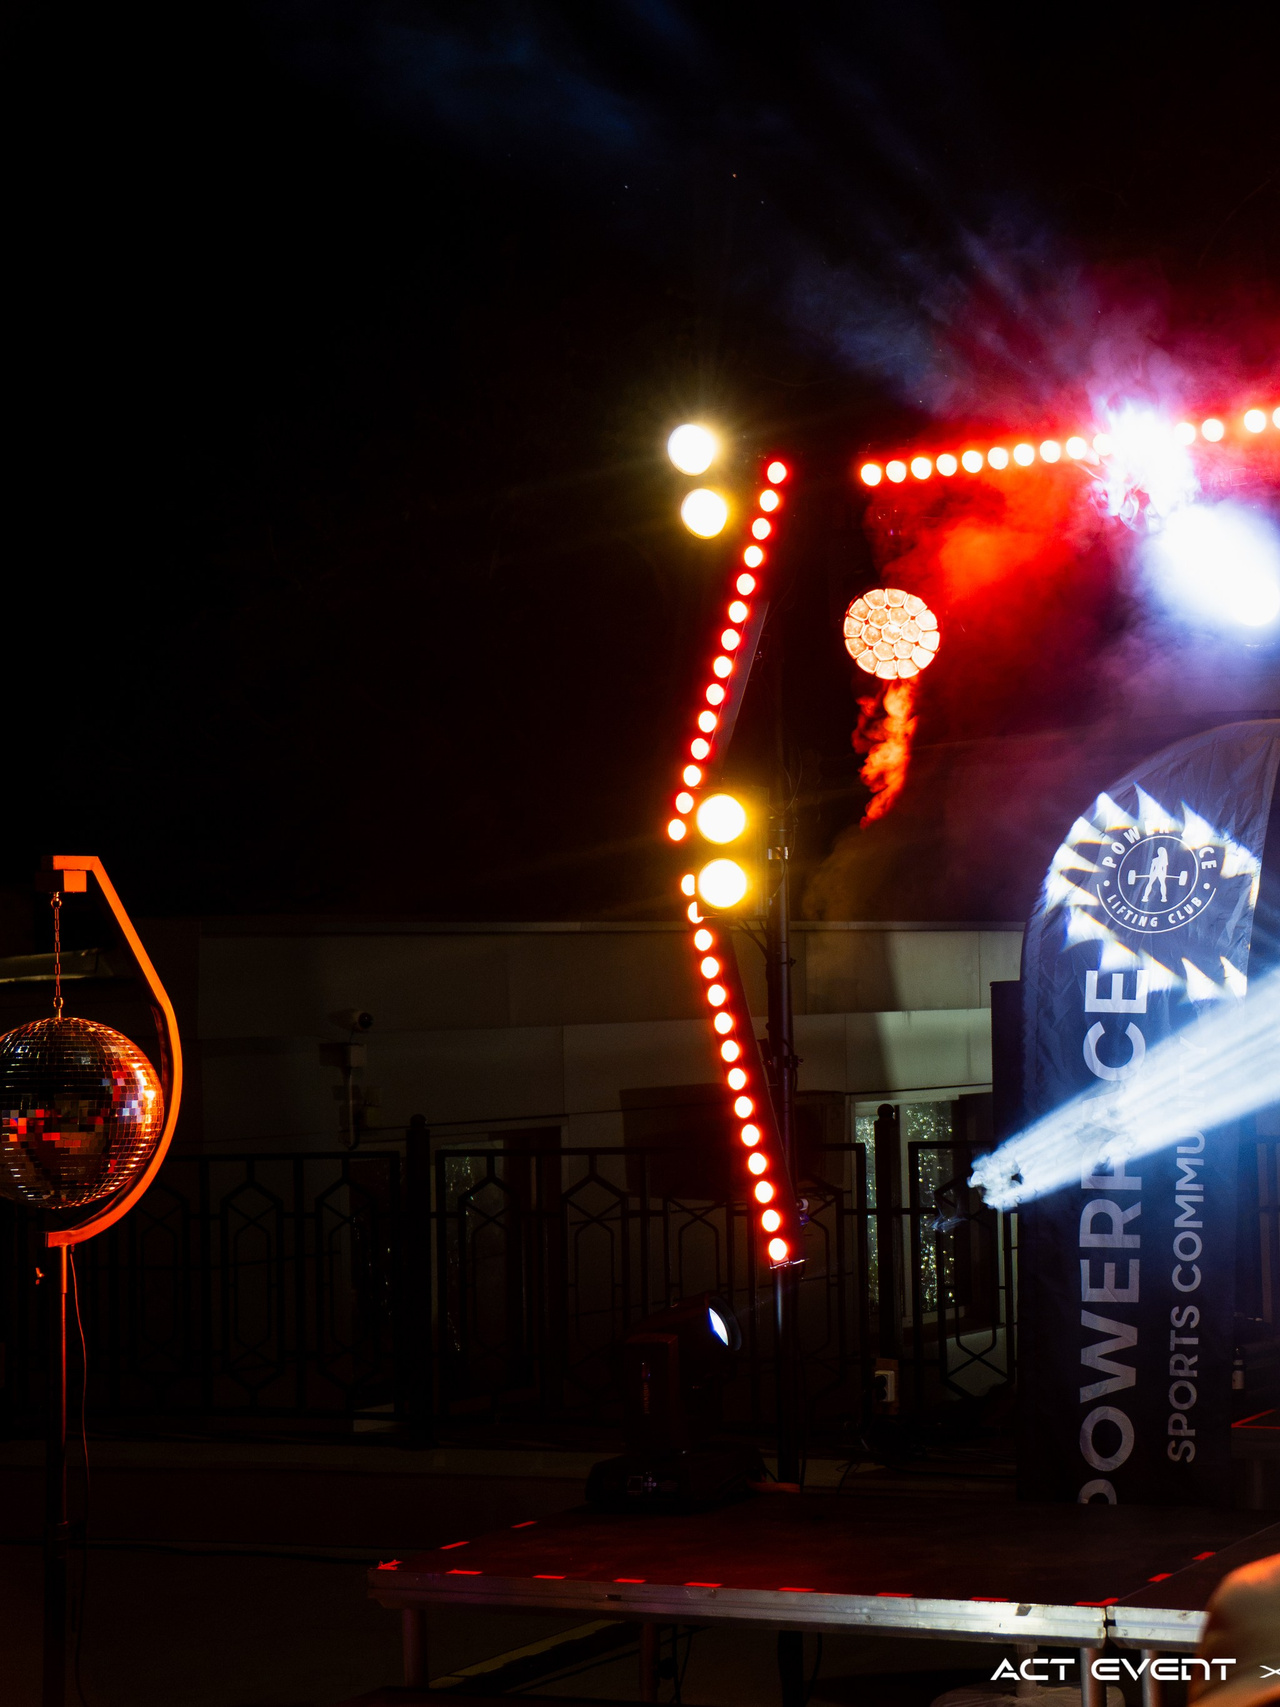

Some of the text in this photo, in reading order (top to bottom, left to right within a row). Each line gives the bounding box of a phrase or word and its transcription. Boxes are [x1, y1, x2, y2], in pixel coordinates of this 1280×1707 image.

[1102, 819, 1217, 870] POWERCE
[1106, 894, 1202, 928] LIFTING CLUB
[1167, 1036, 1209, 1463] SPORTS COMMUITY
